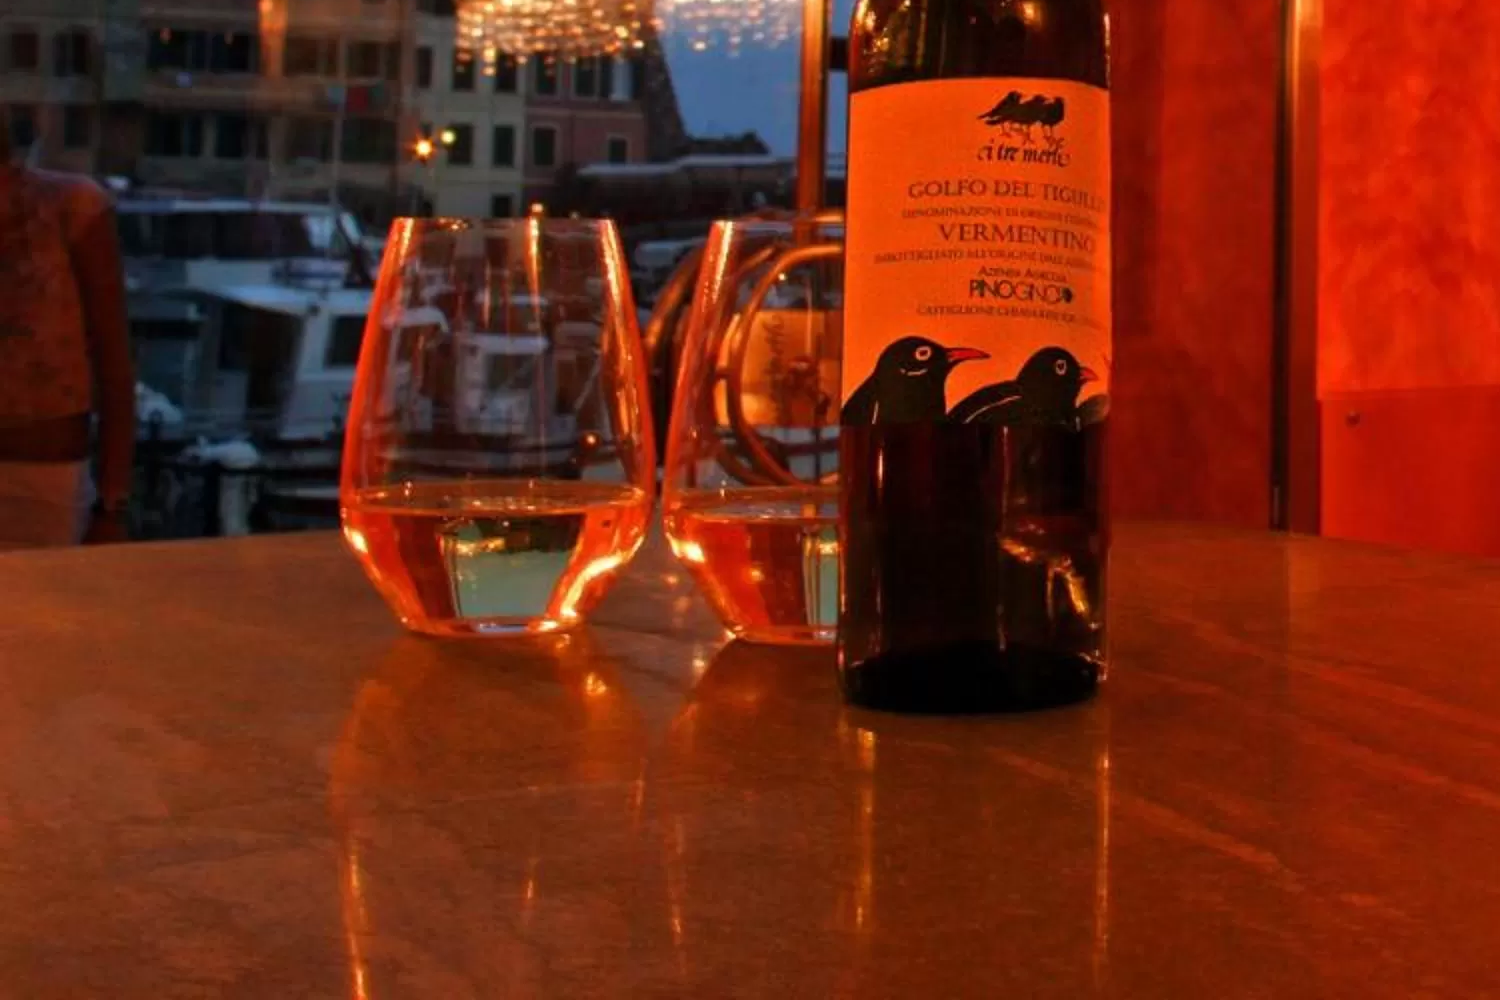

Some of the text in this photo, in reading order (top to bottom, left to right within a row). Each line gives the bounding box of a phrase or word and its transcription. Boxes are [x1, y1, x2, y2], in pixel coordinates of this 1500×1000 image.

[909, 178, 987, 198] GOLFO
[995, 179, 1035, 198] DEL
[938, 223, 1093, 251] VERMENTINO
